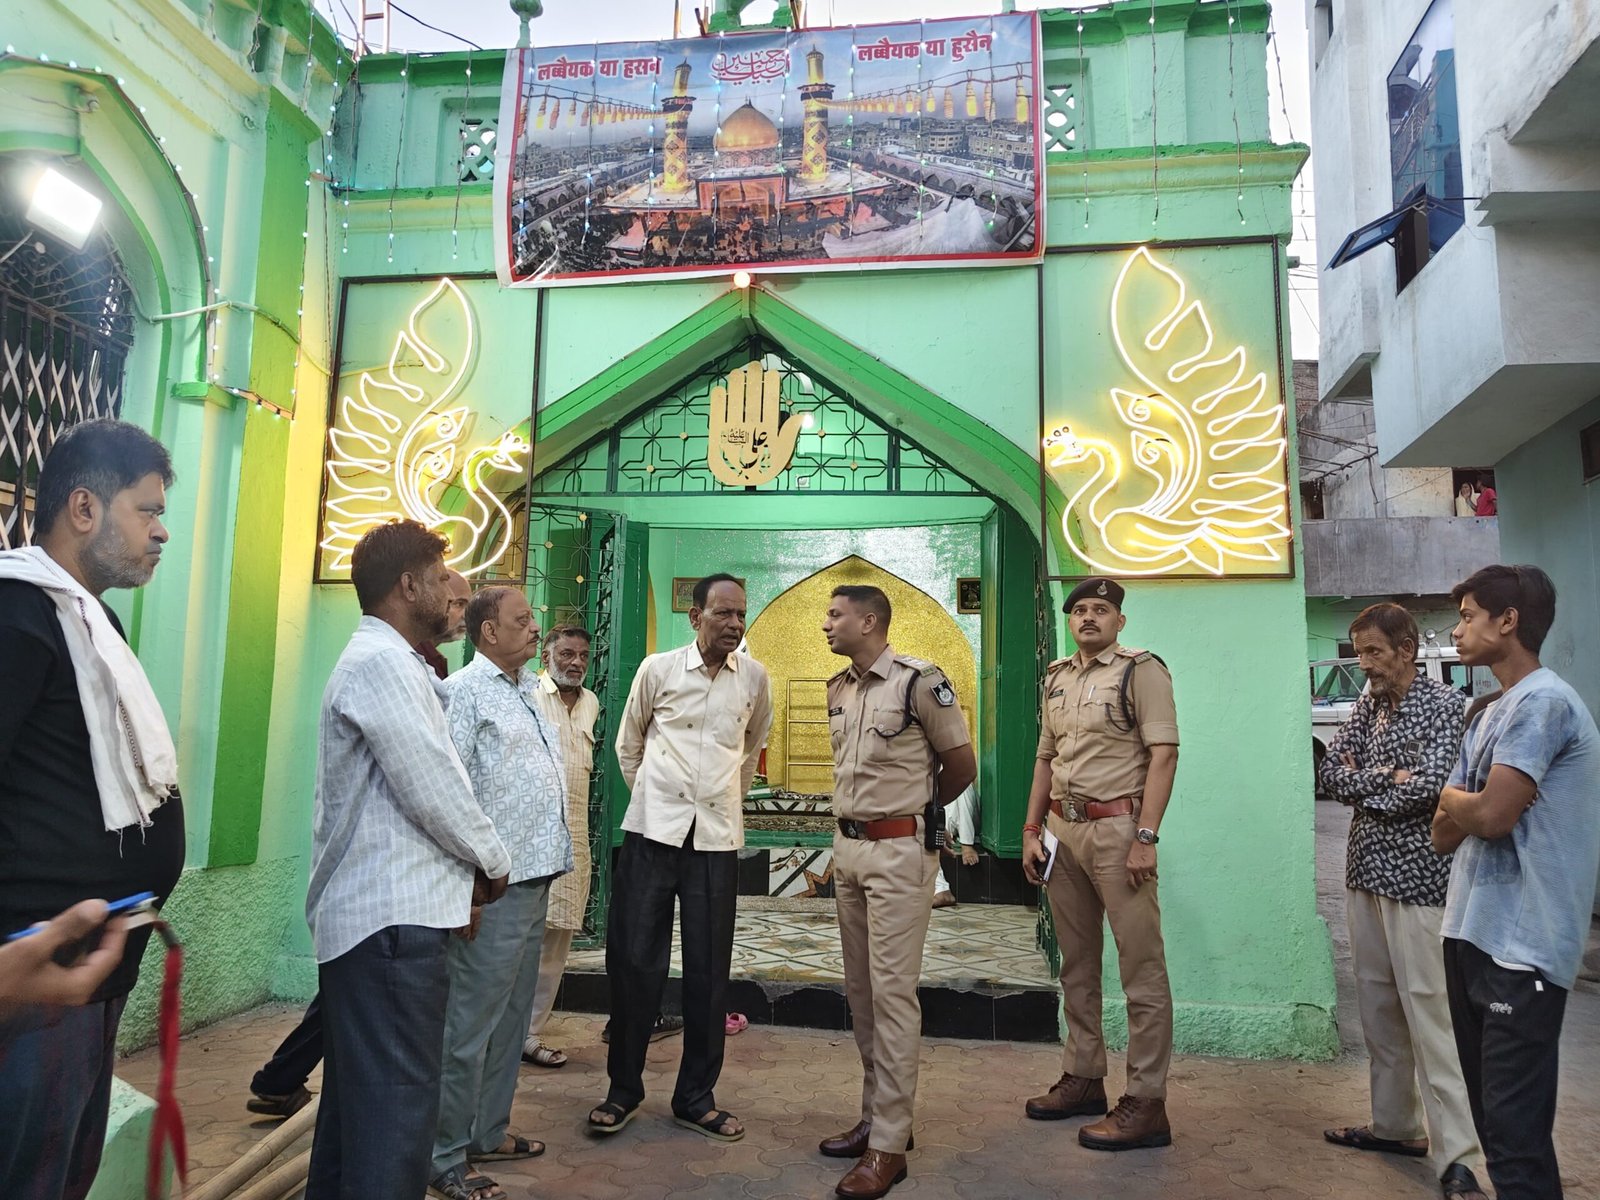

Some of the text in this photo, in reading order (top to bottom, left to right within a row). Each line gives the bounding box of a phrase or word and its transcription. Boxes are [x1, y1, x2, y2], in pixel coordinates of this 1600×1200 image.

[925, 39, 946, 56] या
[951, 30, 992, 62] हुसैन
[600, 60, 619, 76] या
